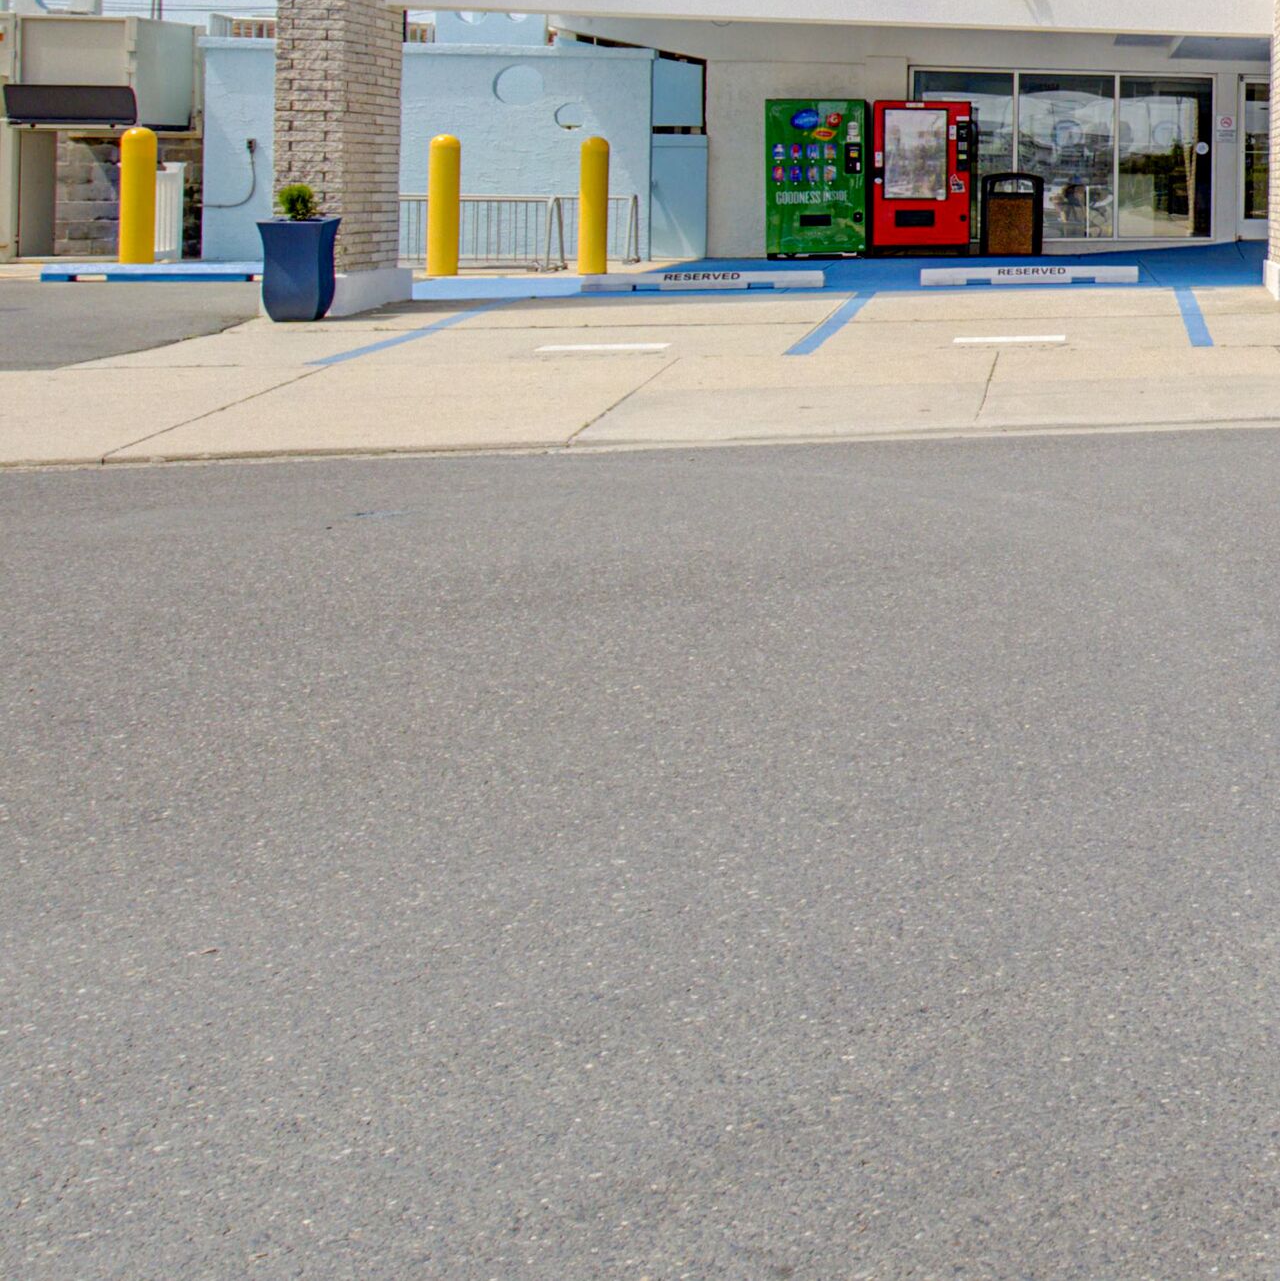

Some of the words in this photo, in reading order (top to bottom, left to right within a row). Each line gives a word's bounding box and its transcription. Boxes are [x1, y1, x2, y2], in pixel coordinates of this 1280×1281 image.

[775, 190, 821, 205] GOODNESS
[822, 189, 848, 202] INSIDE
[997, 267, 1066, 276] RESERVED
[663, 272, 741, 281] RESERVED
